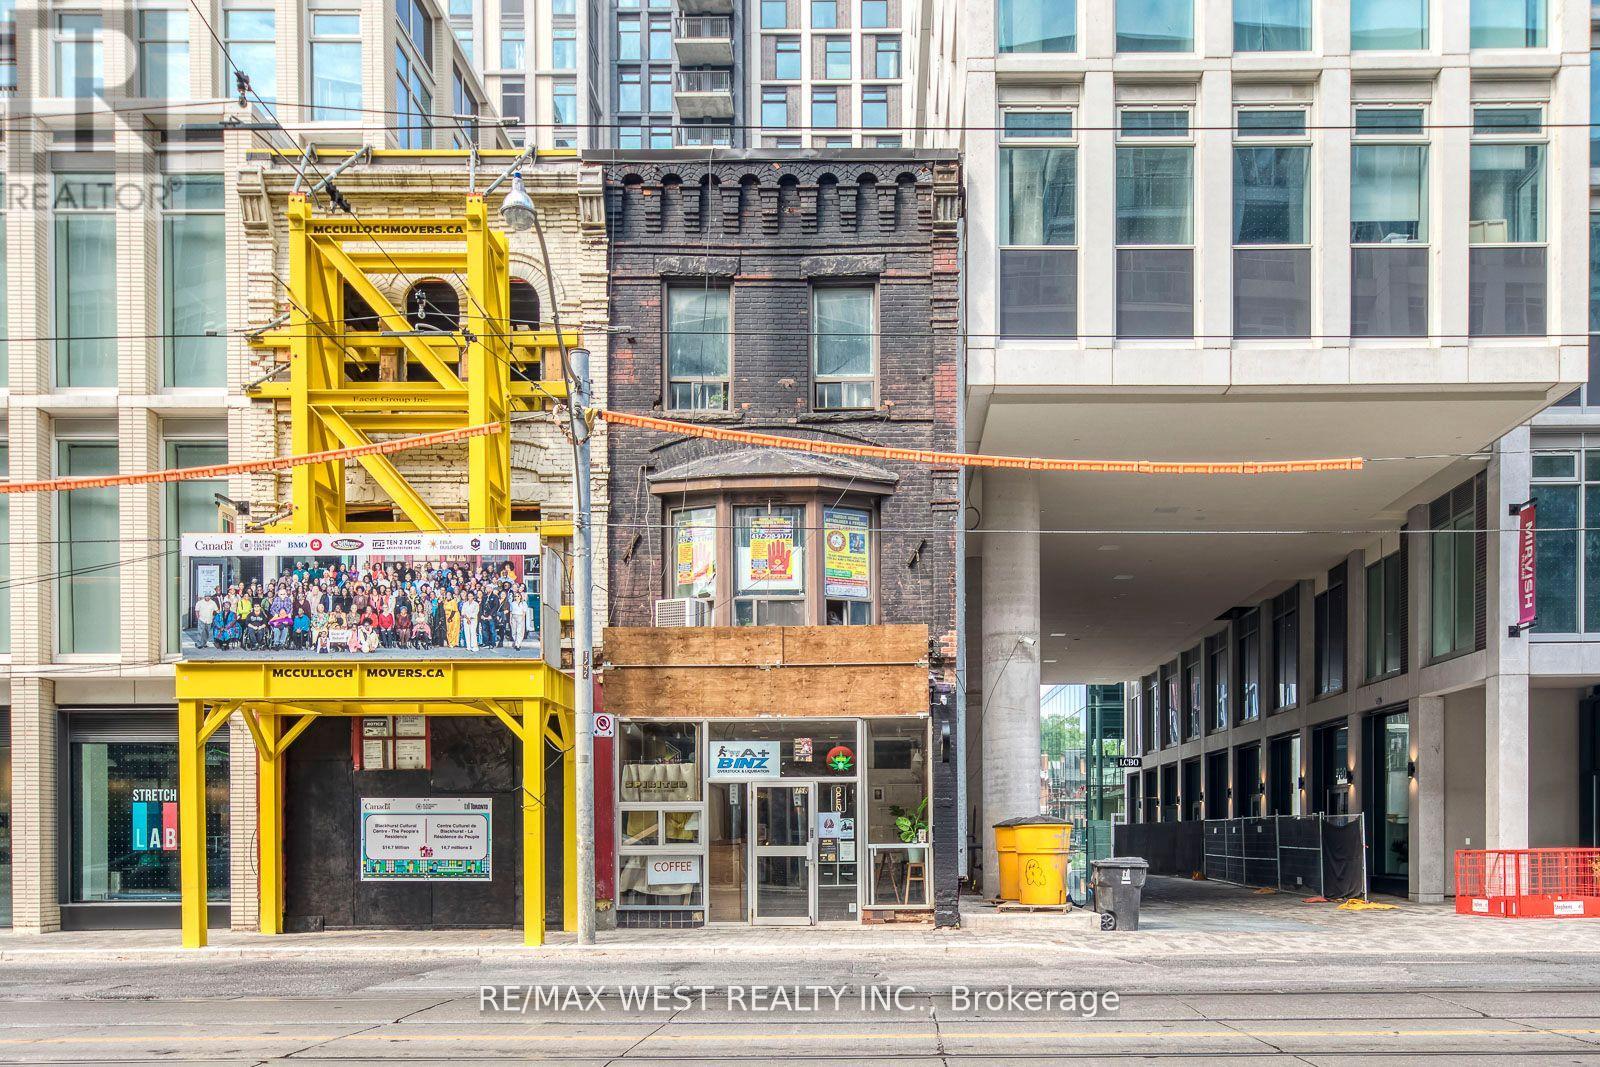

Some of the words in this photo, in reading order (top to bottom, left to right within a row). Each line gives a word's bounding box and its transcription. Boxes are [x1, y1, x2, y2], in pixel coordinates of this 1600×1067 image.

[313, 225, 464, 234] MCCULLOCHMOVERS.CA
[194, 540, 234, 551] Canada
[287, 541, 308, 549] BMO
[499, 541, 527, 550] TORONTO
[1524, 520, 1533, 609] MIRVISH
[272, 668, 354, 678] MCCULLOCH
[366, 668, 445, 678] MOVERS.CA
[740, 748, 770, 758] A+
[717, 757, 770, 769] BINZ
[1119, 758, 1139, 766] LCBO
[625, 780, 688, 789] SPIRITED
[132, 788, 177, 802] STRETCH
[364, 802, 391, 810] Canada
[470, 802, 488, 810] TORONTO
[136, 827, 176, 848] LAB
[653, 861, 693, 872] COFFEE
